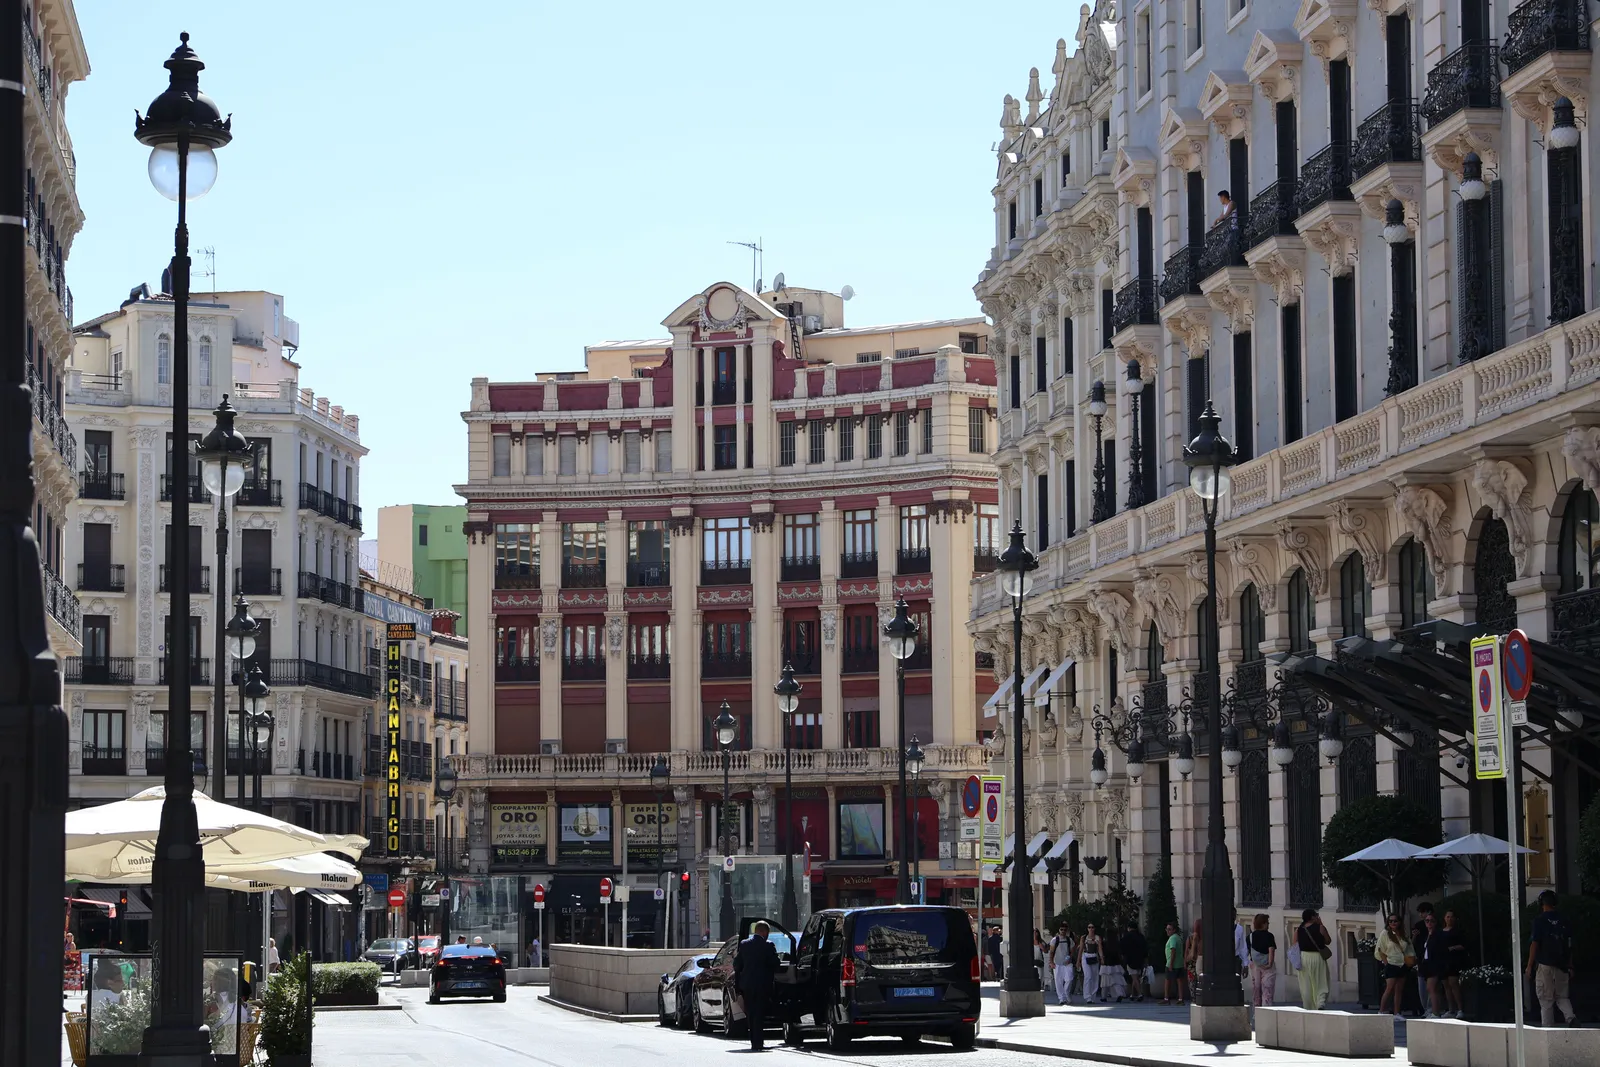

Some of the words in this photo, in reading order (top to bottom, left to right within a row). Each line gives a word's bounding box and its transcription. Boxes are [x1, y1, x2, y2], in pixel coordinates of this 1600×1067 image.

[388, 645, 399, 661] H
[388, 678, 399, 851] CANTABRICO
[500, 812, 538, 823] ORO
[633, 814, 670, 824] ORO
[497, 848, 506, 856] 91
[507, 848, 520, 856] 532
[530, 848, 540, 856] 37
[320, 873, 348, 883] Mahou
[249, 880, 277, 888] Maho
